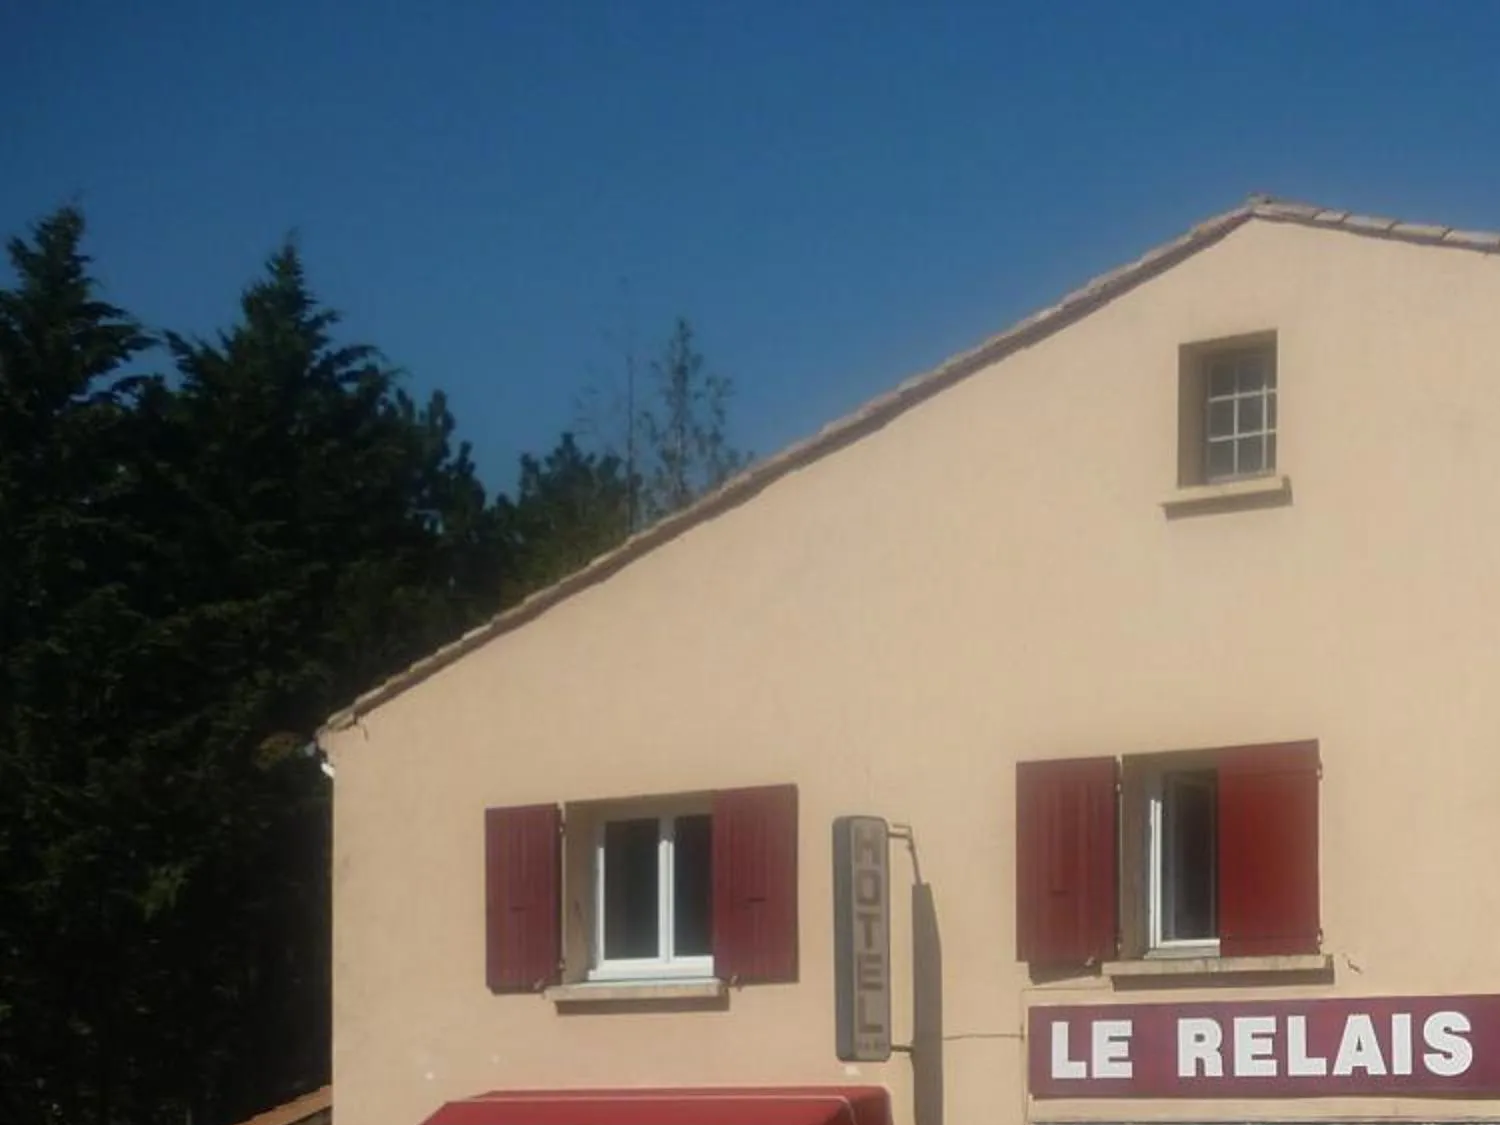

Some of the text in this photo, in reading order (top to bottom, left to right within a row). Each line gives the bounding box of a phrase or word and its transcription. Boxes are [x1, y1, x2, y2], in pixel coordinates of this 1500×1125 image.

[853, 824, 884, 1034] HOTEL
[1051, 1020, 1132, 1079] LE
[1177, 1010, 1473, 1078] RELAIS
